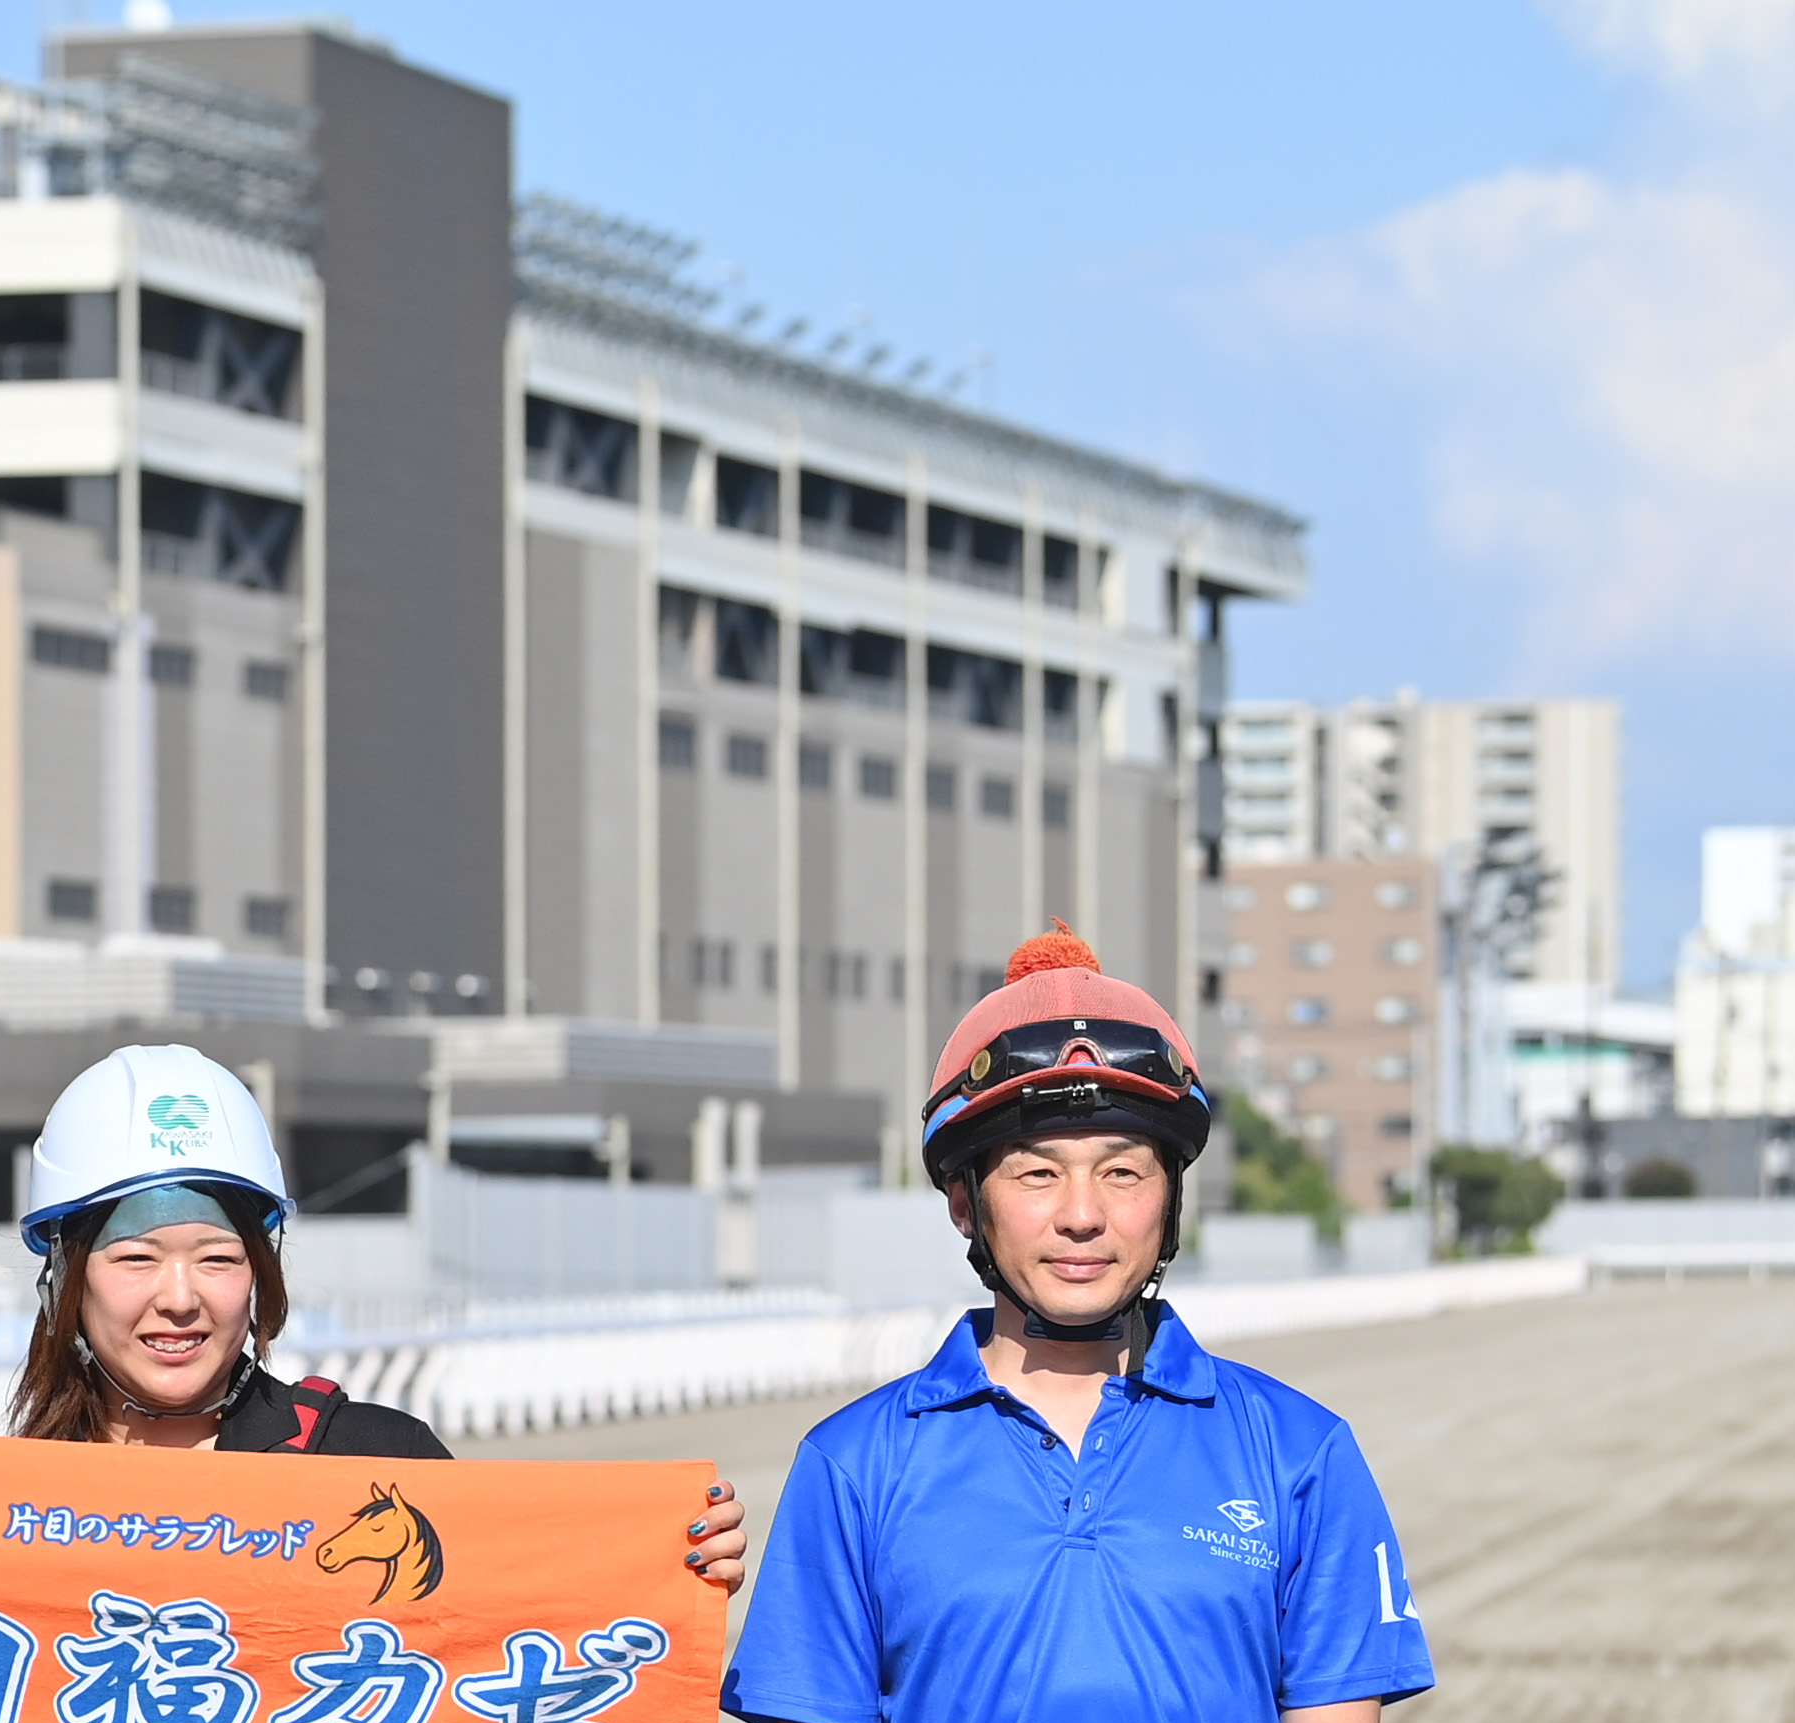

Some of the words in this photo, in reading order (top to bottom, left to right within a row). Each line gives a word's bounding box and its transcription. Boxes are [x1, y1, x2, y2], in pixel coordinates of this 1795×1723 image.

[150, 1131, 213, 1148] KAWASAKI
[4, 1502, 315, 1561] 片目のサラブレッド
[1182, 1526, 1236, 1548] SAKAI
[1210, 1545, 1242, 1563] Since
[1244, 1555, 1271, 1572] 202
[1373, 1541, 1419, 1625] 1
